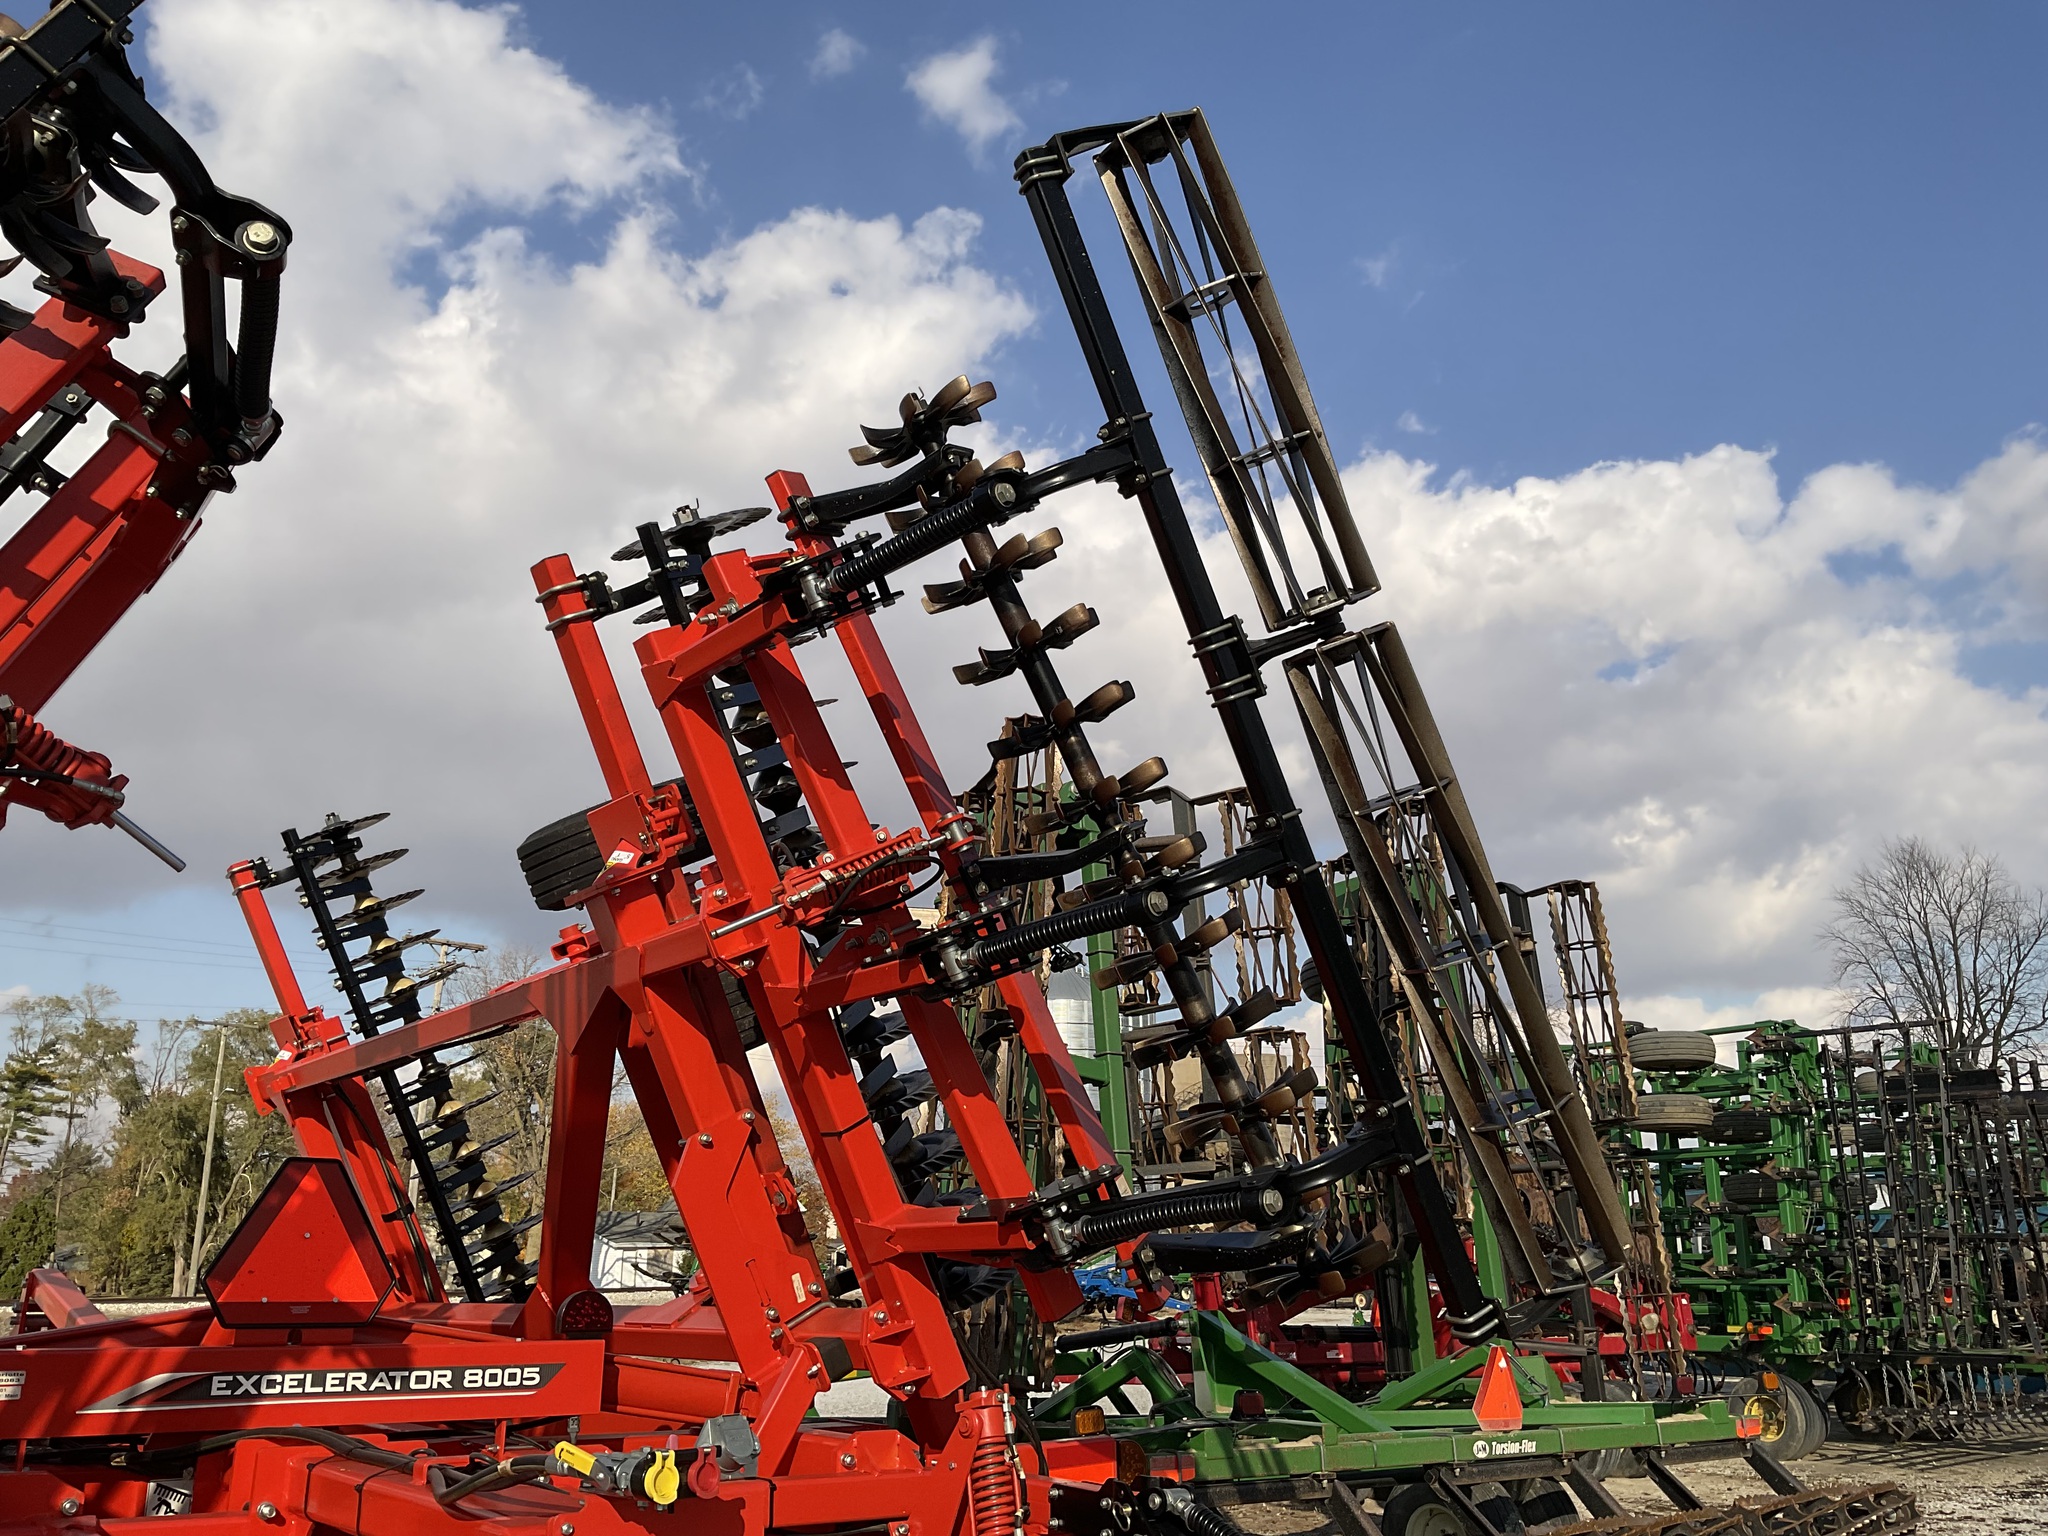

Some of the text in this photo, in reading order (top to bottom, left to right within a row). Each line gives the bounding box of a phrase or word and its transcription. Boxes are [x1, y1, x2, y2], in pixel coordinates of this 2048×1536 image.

[210, 1367, 541, 1396] EXCELERATOR 8005
[1491, 1439, 1537, 1456] Torsion-Flex
